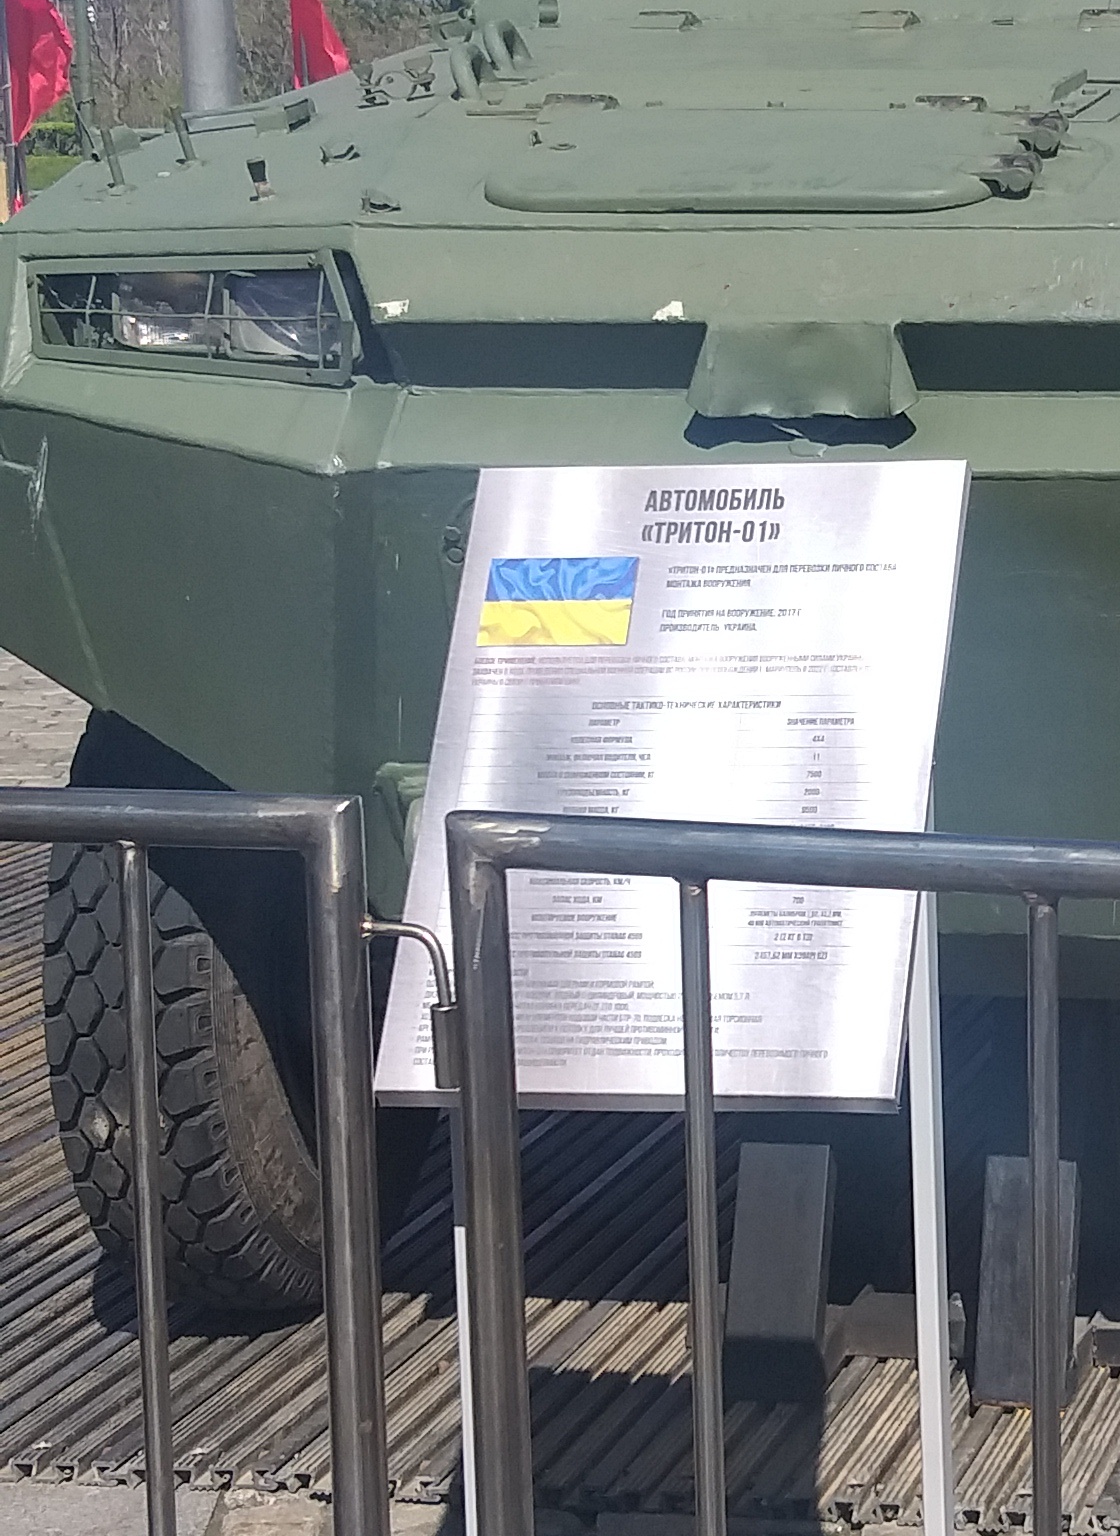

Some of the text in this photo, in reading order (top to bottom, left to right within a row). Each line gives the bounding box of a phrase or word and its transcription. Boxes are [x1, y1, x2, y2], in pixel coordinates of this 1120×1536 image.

[644, 487, 786, 512] АВТОМОБИЛЬ
[641, 520, 781, 544] «ТРИТОН-01»
[716, 565, 772, 574] ПРЕДНАЗНАЧЕН
[772, 564, 788, 574] ДЛЯ
[661, 609, 677, 619] ГОД
[716, 609, 726, 617] НА
[777, 609, 796, 617] 2017
